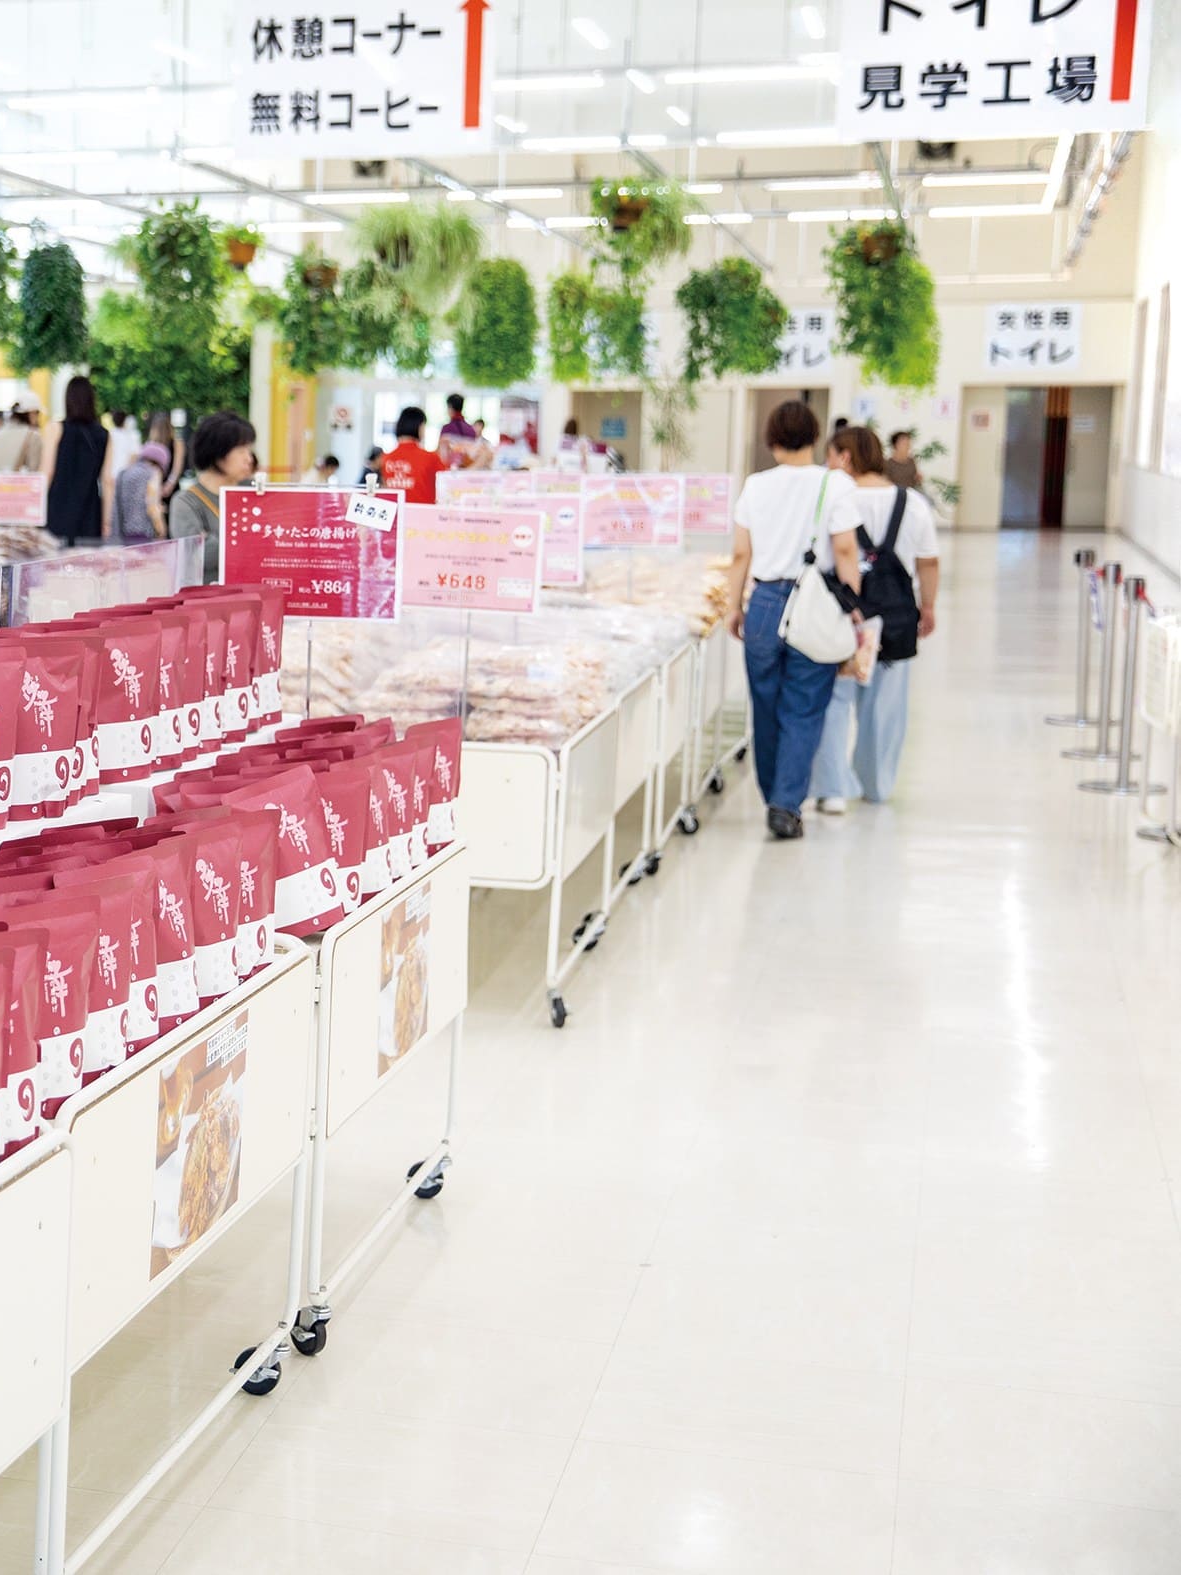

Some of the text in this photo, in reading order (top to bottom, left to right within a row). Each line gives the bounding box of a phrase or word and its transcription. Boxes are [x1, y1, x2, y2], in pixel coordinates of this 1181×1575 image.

[254, 13, 441, 60] 休憩コーナー
[858, 56, 1097, 110] 見学工場
[251, 91, 438, 132] 無料コーヒー
[990, 339, 1074, 365] トイレ
[311, 579, 352, 595] ¥864
[437, 573, 486, 591] ¥648
